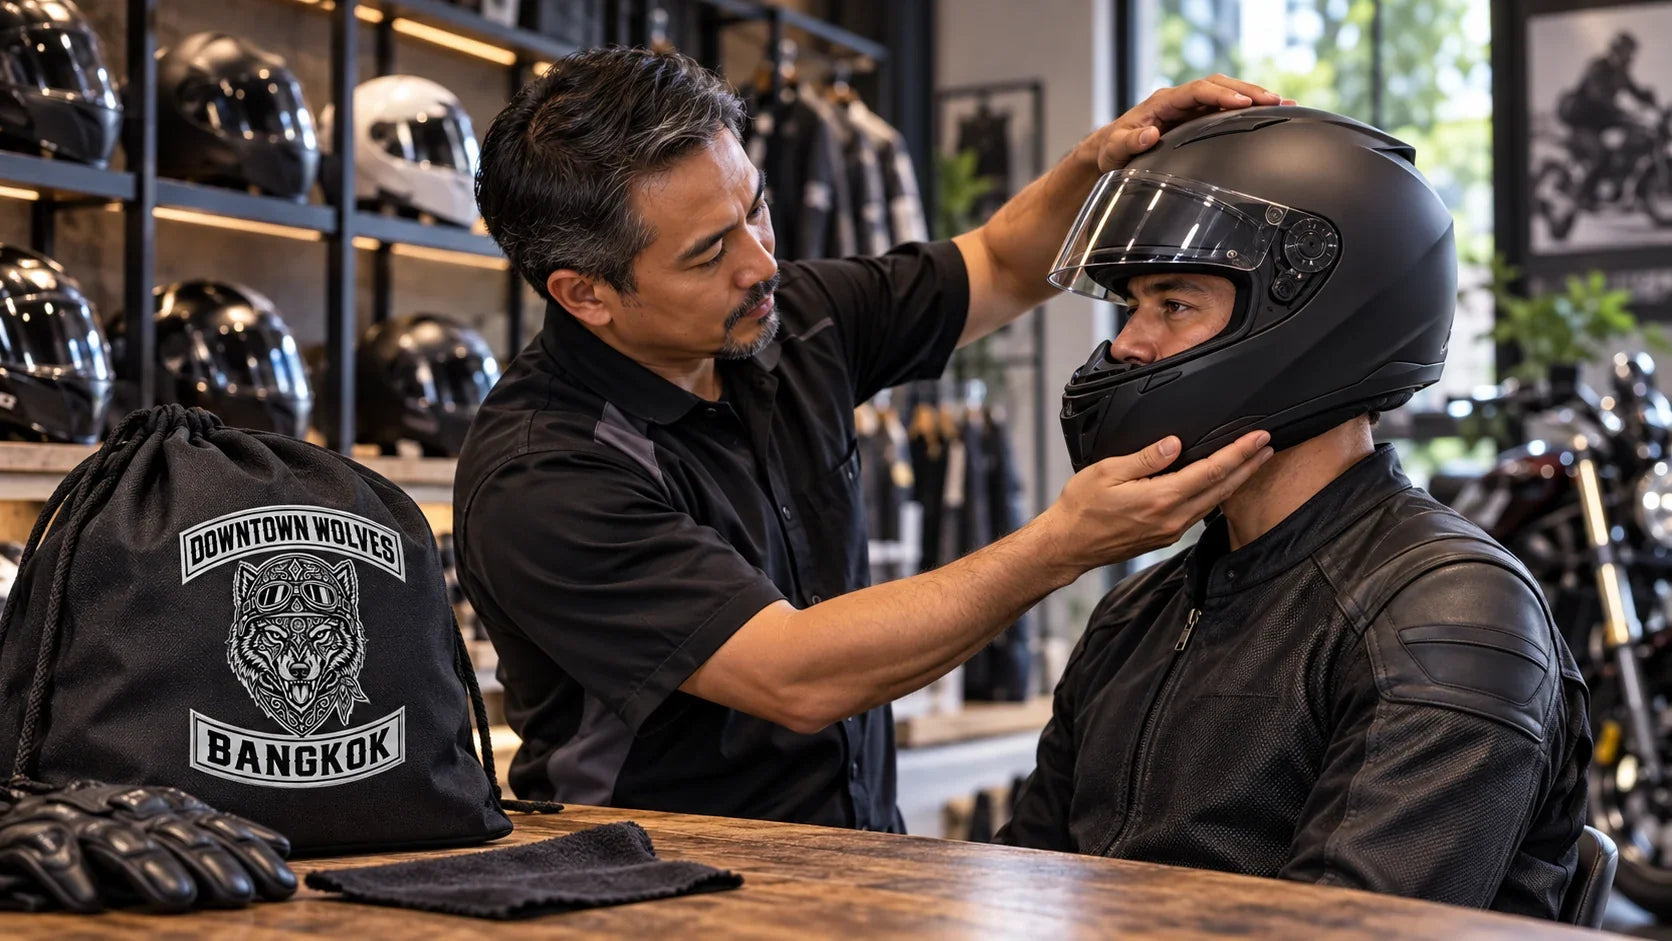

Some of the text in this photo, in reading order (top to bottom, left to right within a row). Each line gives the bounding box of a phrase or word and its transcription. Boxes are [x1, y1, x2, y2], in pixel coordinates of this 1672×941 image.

[190, 515, 395, 566] DOWNTOWN WOLVES
[207, 727, 390, 777] BANGKOK
